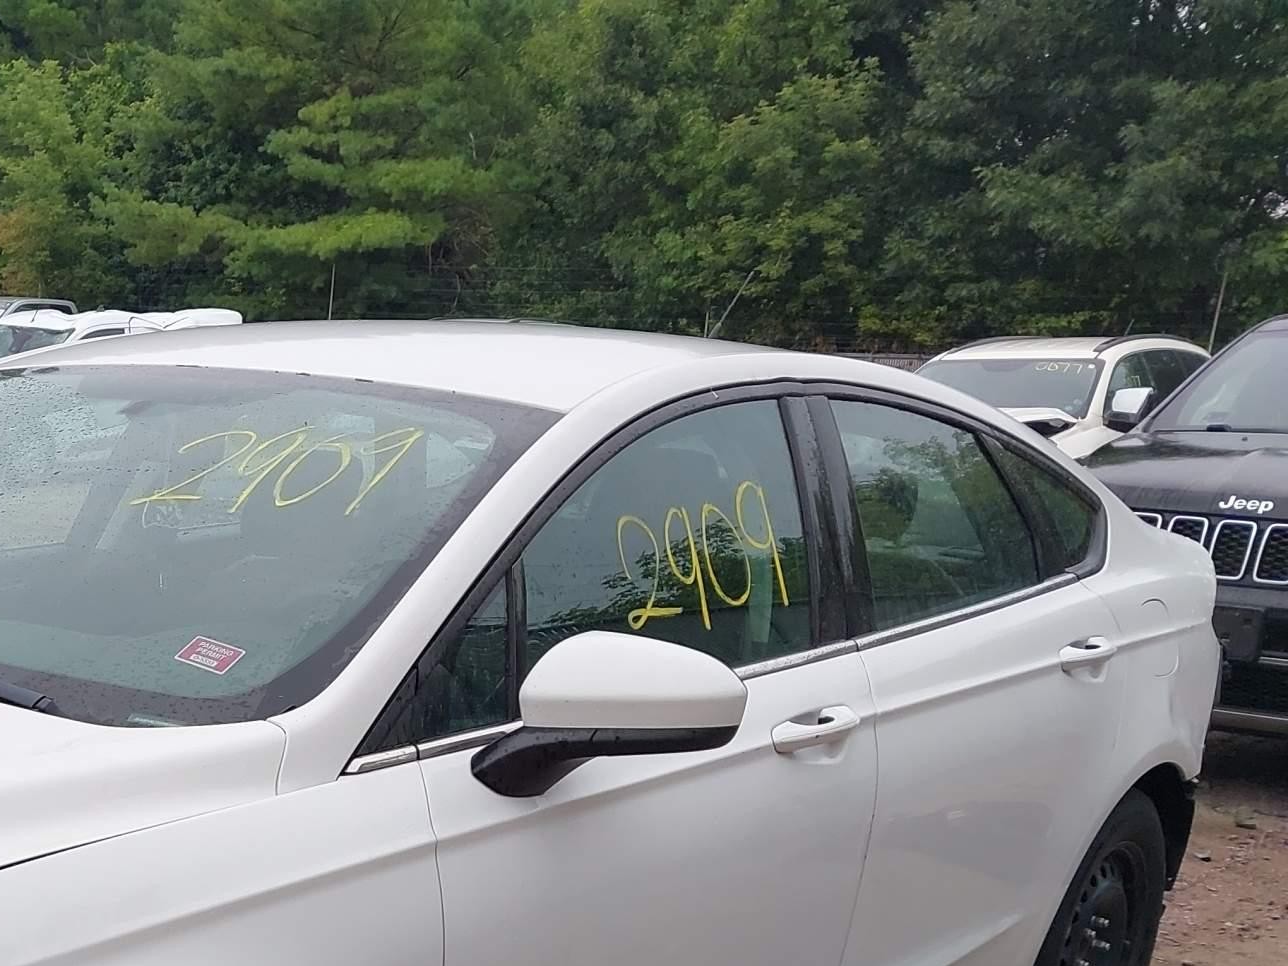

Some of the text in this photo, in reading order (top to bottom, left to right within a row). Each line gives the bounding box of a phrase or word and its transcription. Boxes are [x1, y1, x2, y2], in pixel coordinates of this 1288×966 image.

[129, 425, 424, 516] 2909
[1219, 495, 1274, 514] Jeep
[617, 480, 789, 631] 2909
[196, 647, 227, 661] PERMIT
[198, 641, 234, 656] PARKING
